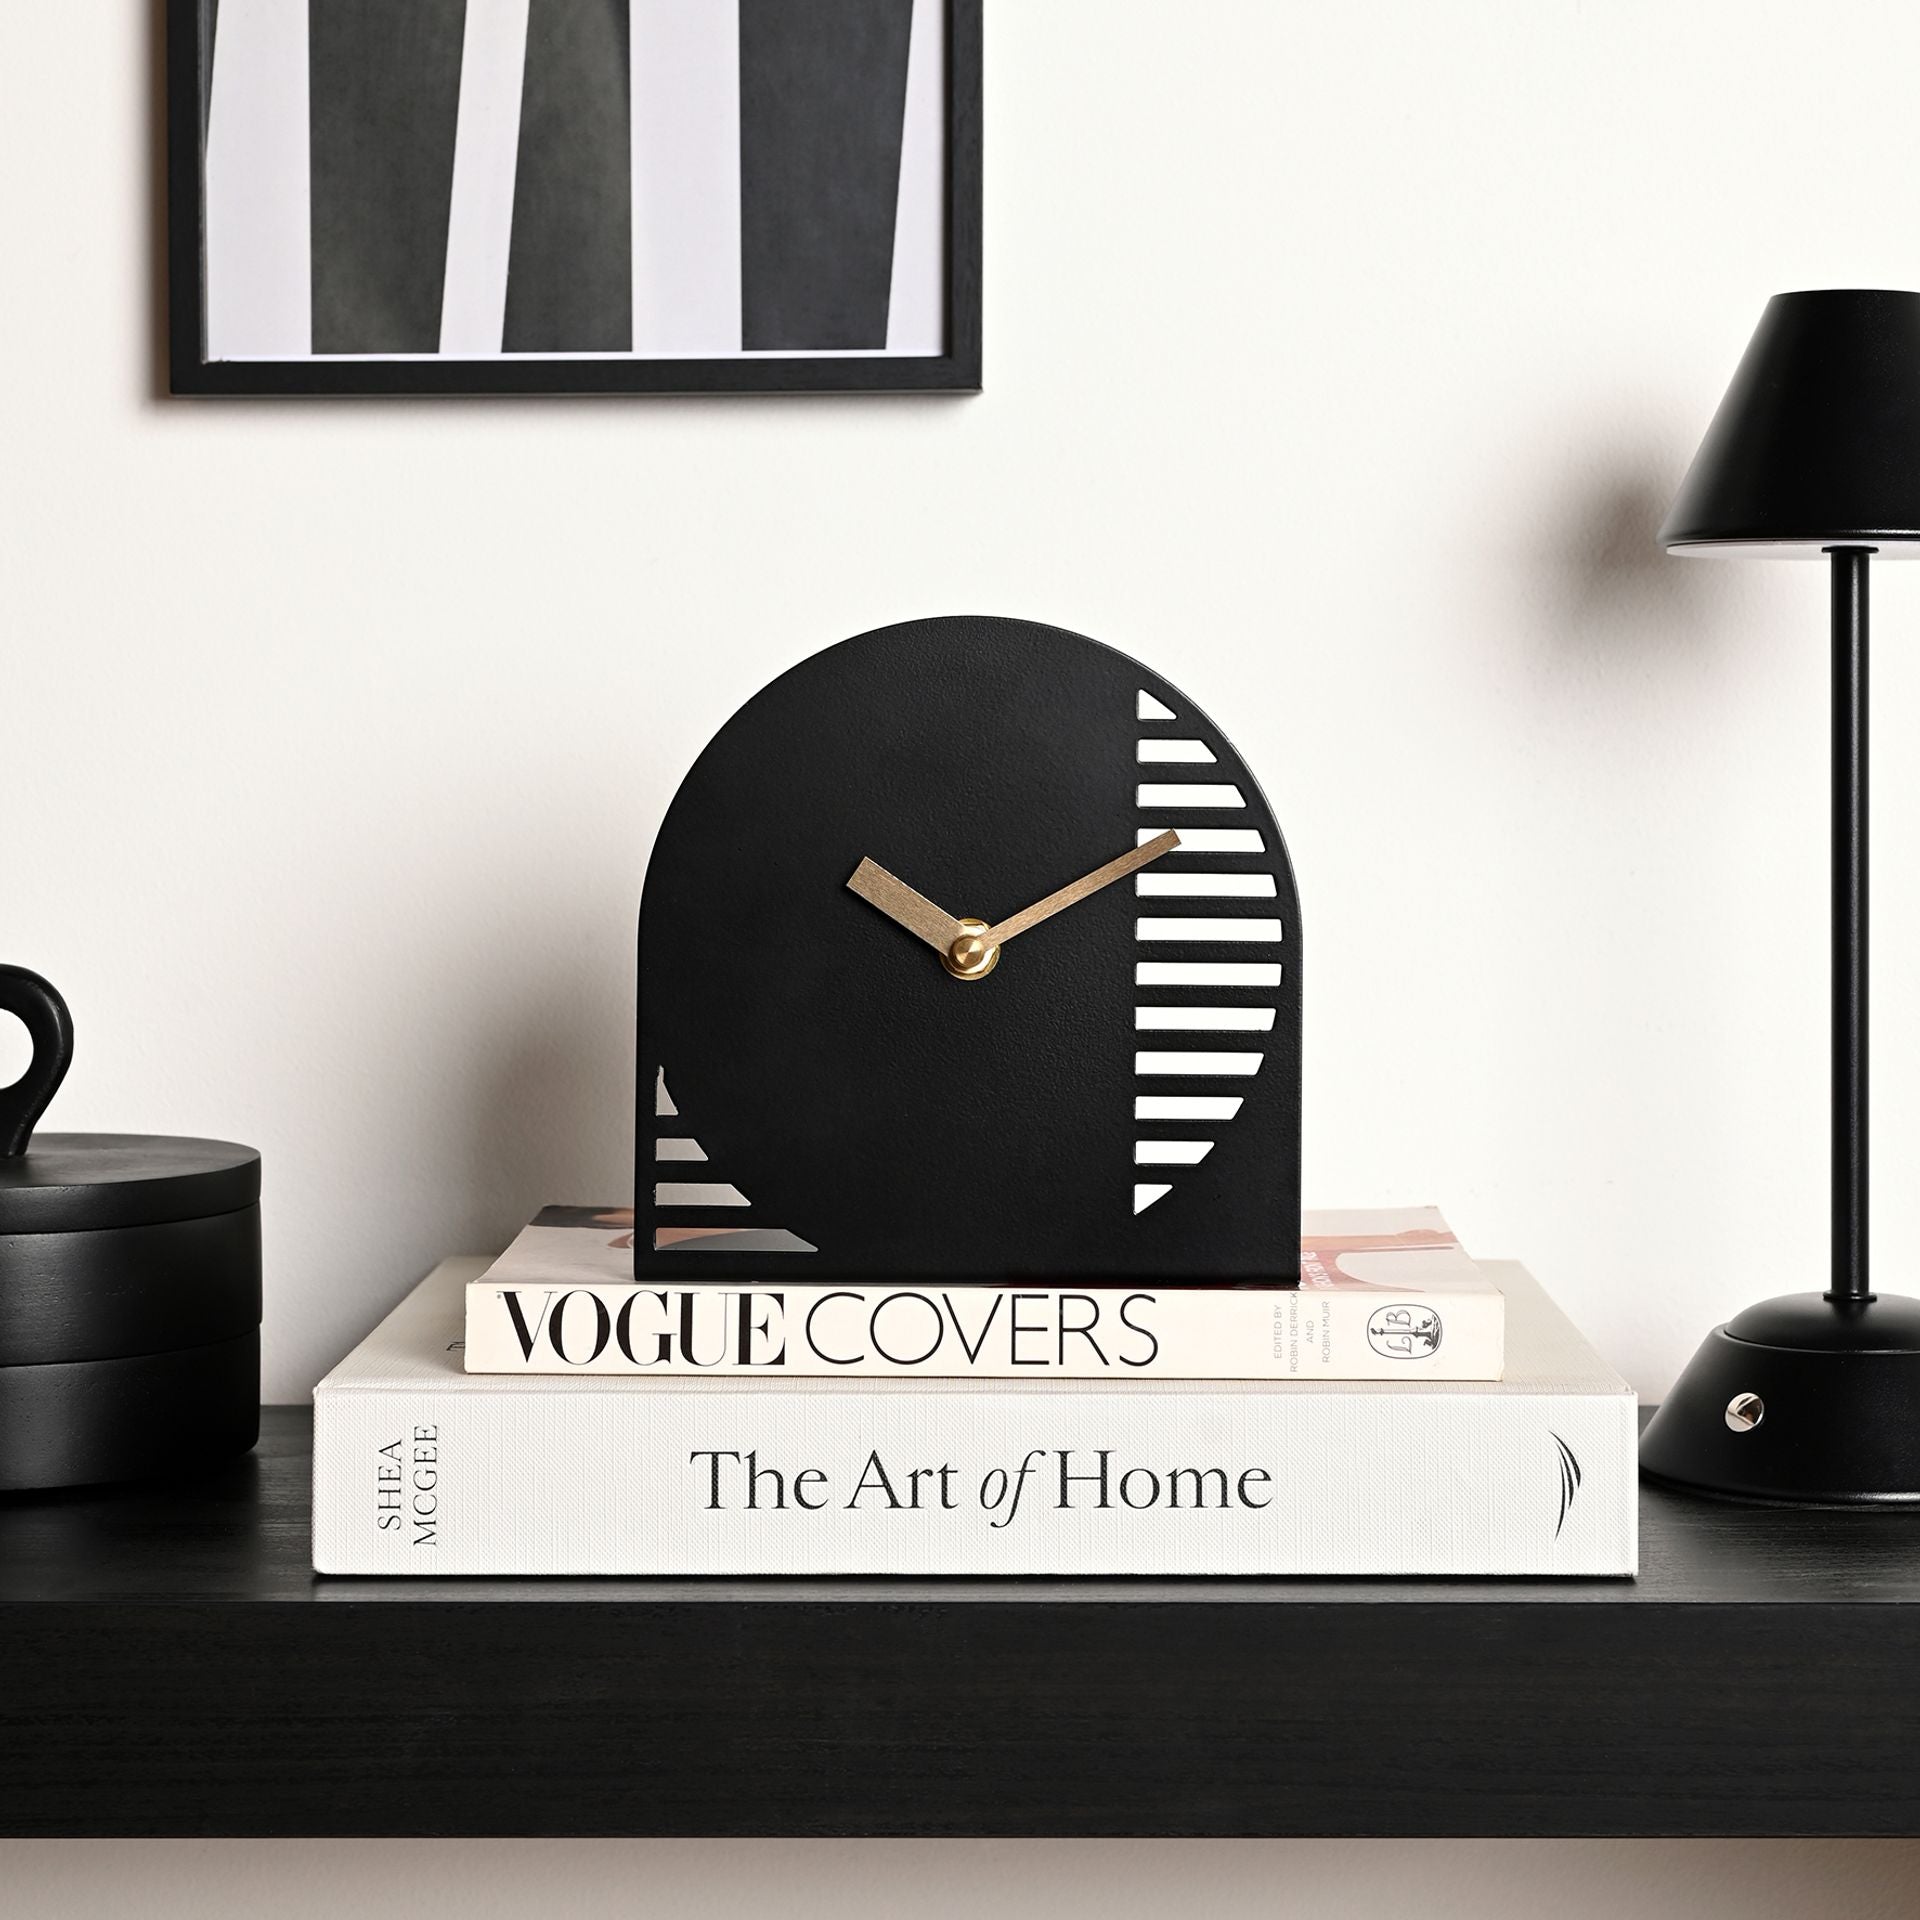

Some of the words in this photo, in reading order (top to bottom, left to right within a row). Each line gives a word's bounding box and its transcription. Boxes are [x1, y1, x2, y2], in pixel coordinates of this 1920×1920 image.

[496, 1290, 786, 1367] VOGUE
[805, 1292, 1159, 1367] COVERS
[1273, 1304, 1282, 1319] BY
[1290, 1292, 1298, 1336] DERRICK
[1322, 1301, 1331, 1327] MUIR
[1273, 1321, 1282, 1359] EDITED
[1306, 1320, 1314, 1344] AND
[1322, 1330, 1331, 1363] ROBIN
[1290, 1339, 1298, 1373] ROBIN
[377, 1439, 402, 1531] SHEA
[413, 1424, 438, 1546] MCGEE
[689, 1449, 830, 1510] The
[843, 1449, 959, 1510] Art
[979, 1449, 1046, 1528] of
[1053, 1449, 1274, 1510] Home
